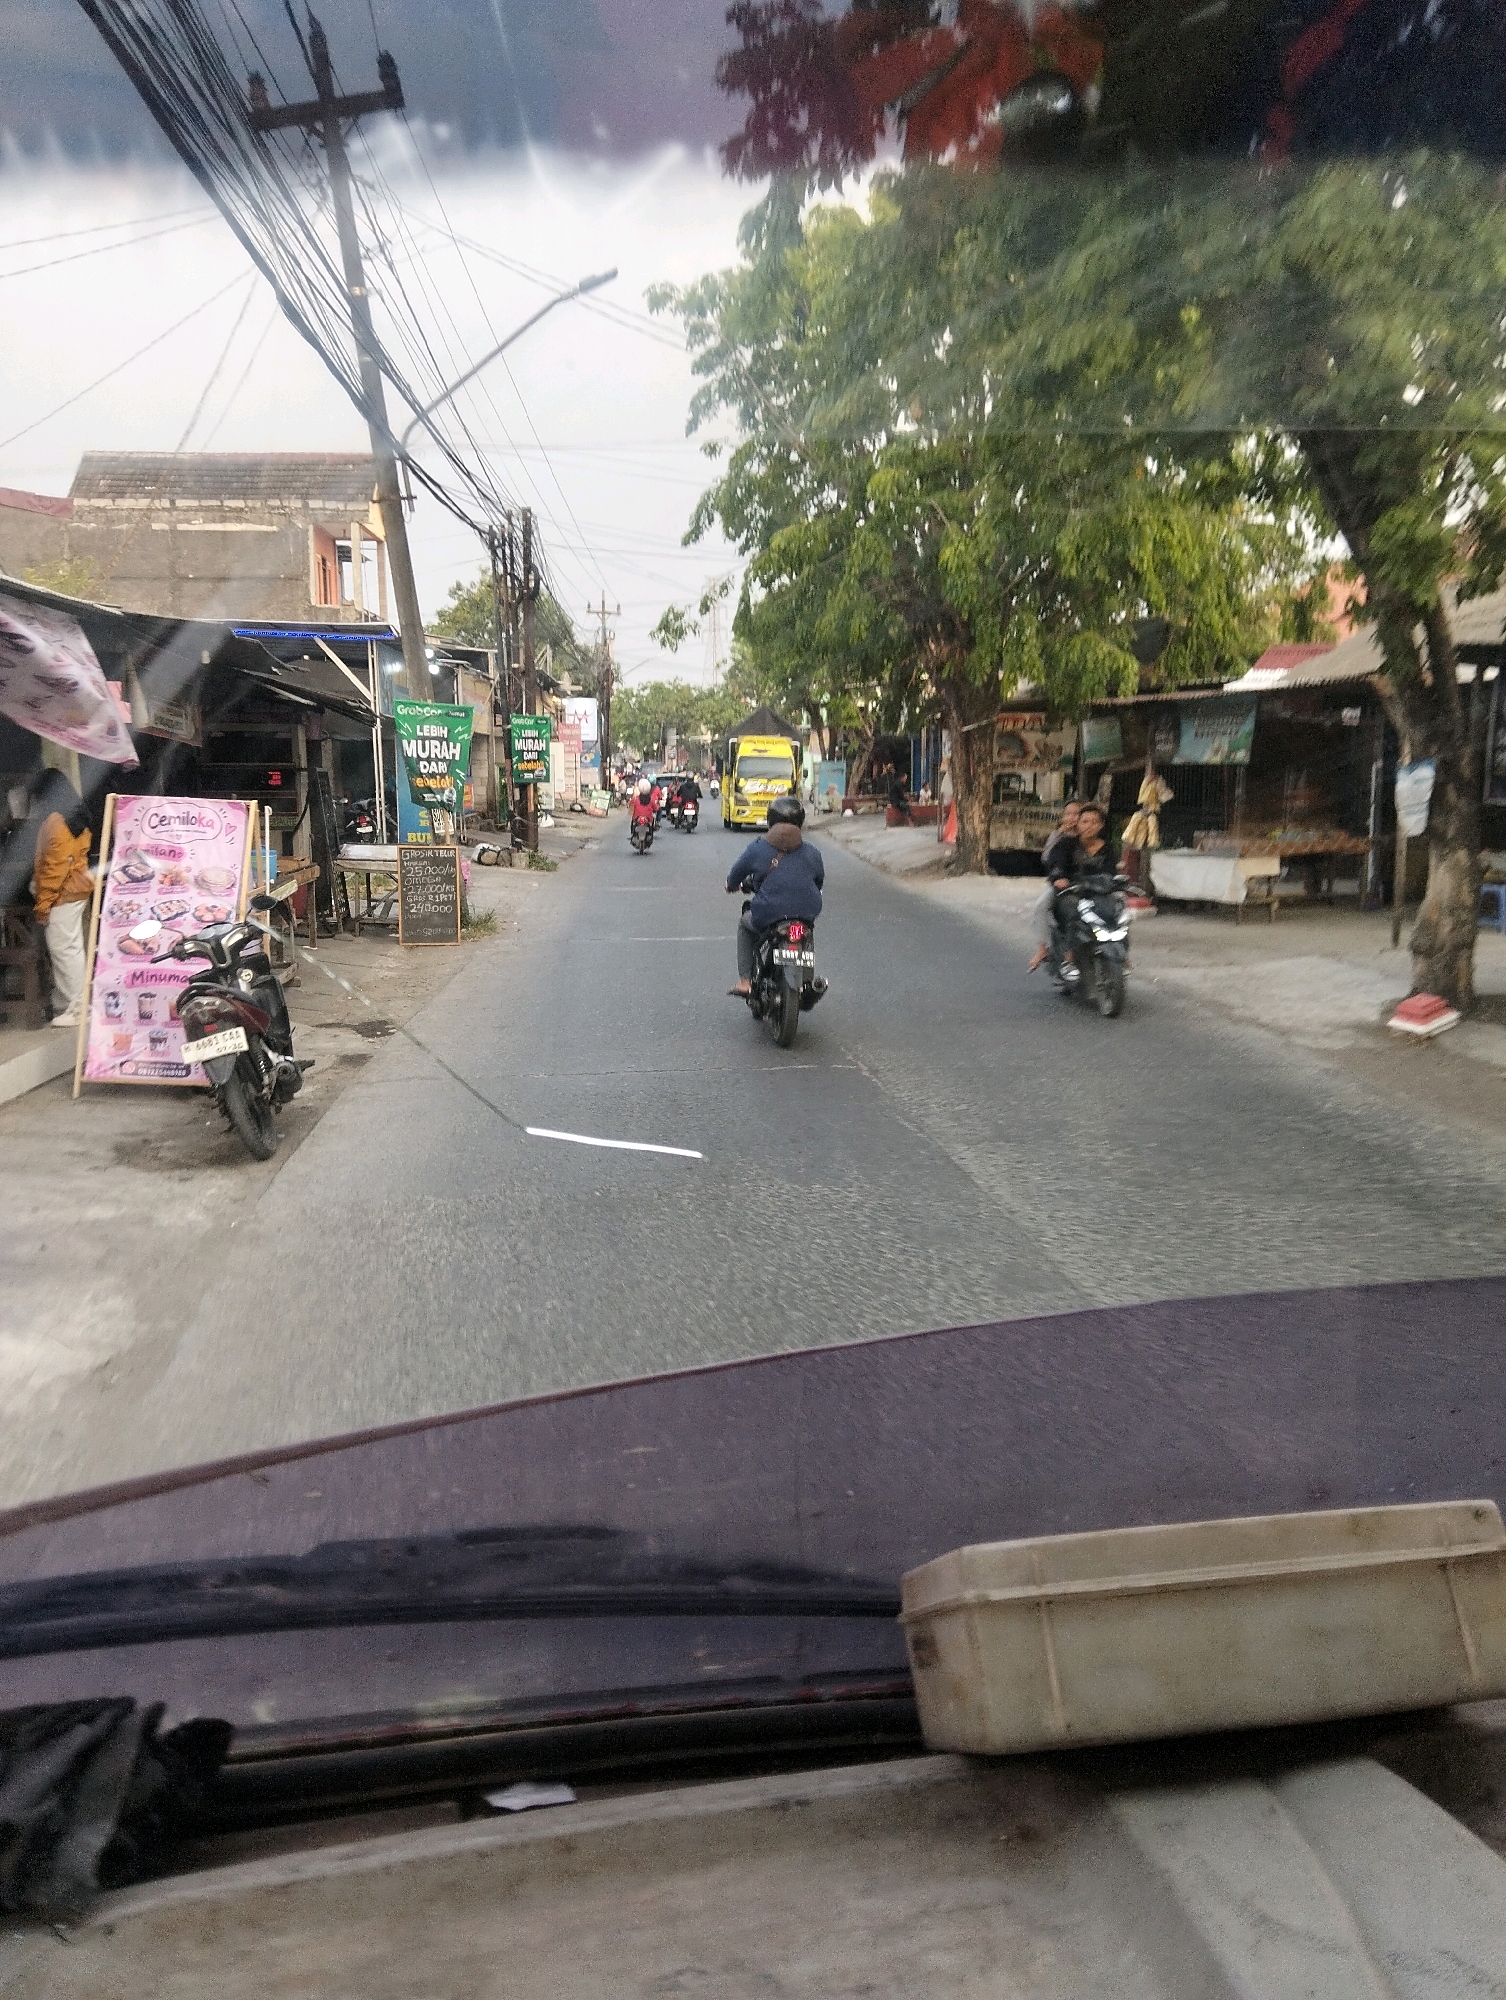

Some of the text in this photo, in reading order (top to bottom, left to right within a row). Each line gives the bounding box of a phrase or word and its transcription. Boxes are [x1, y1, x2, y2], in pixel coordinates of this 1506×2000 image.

[416, 724, 448, 739] LEBIH
[521, 729, 539, 738] LEBIH
[402, 739, 461, 761] MURAH
[514, 738, 546, 751] MURAH
[523, 751, 538, 760] DARI
[420, 761, 448, 774] DARI
[148, 810, 215, 830] Cemiloka
[401, 849, 456, 861] GROSIR TELUR
[131, 970, 190, 986] Minuma
